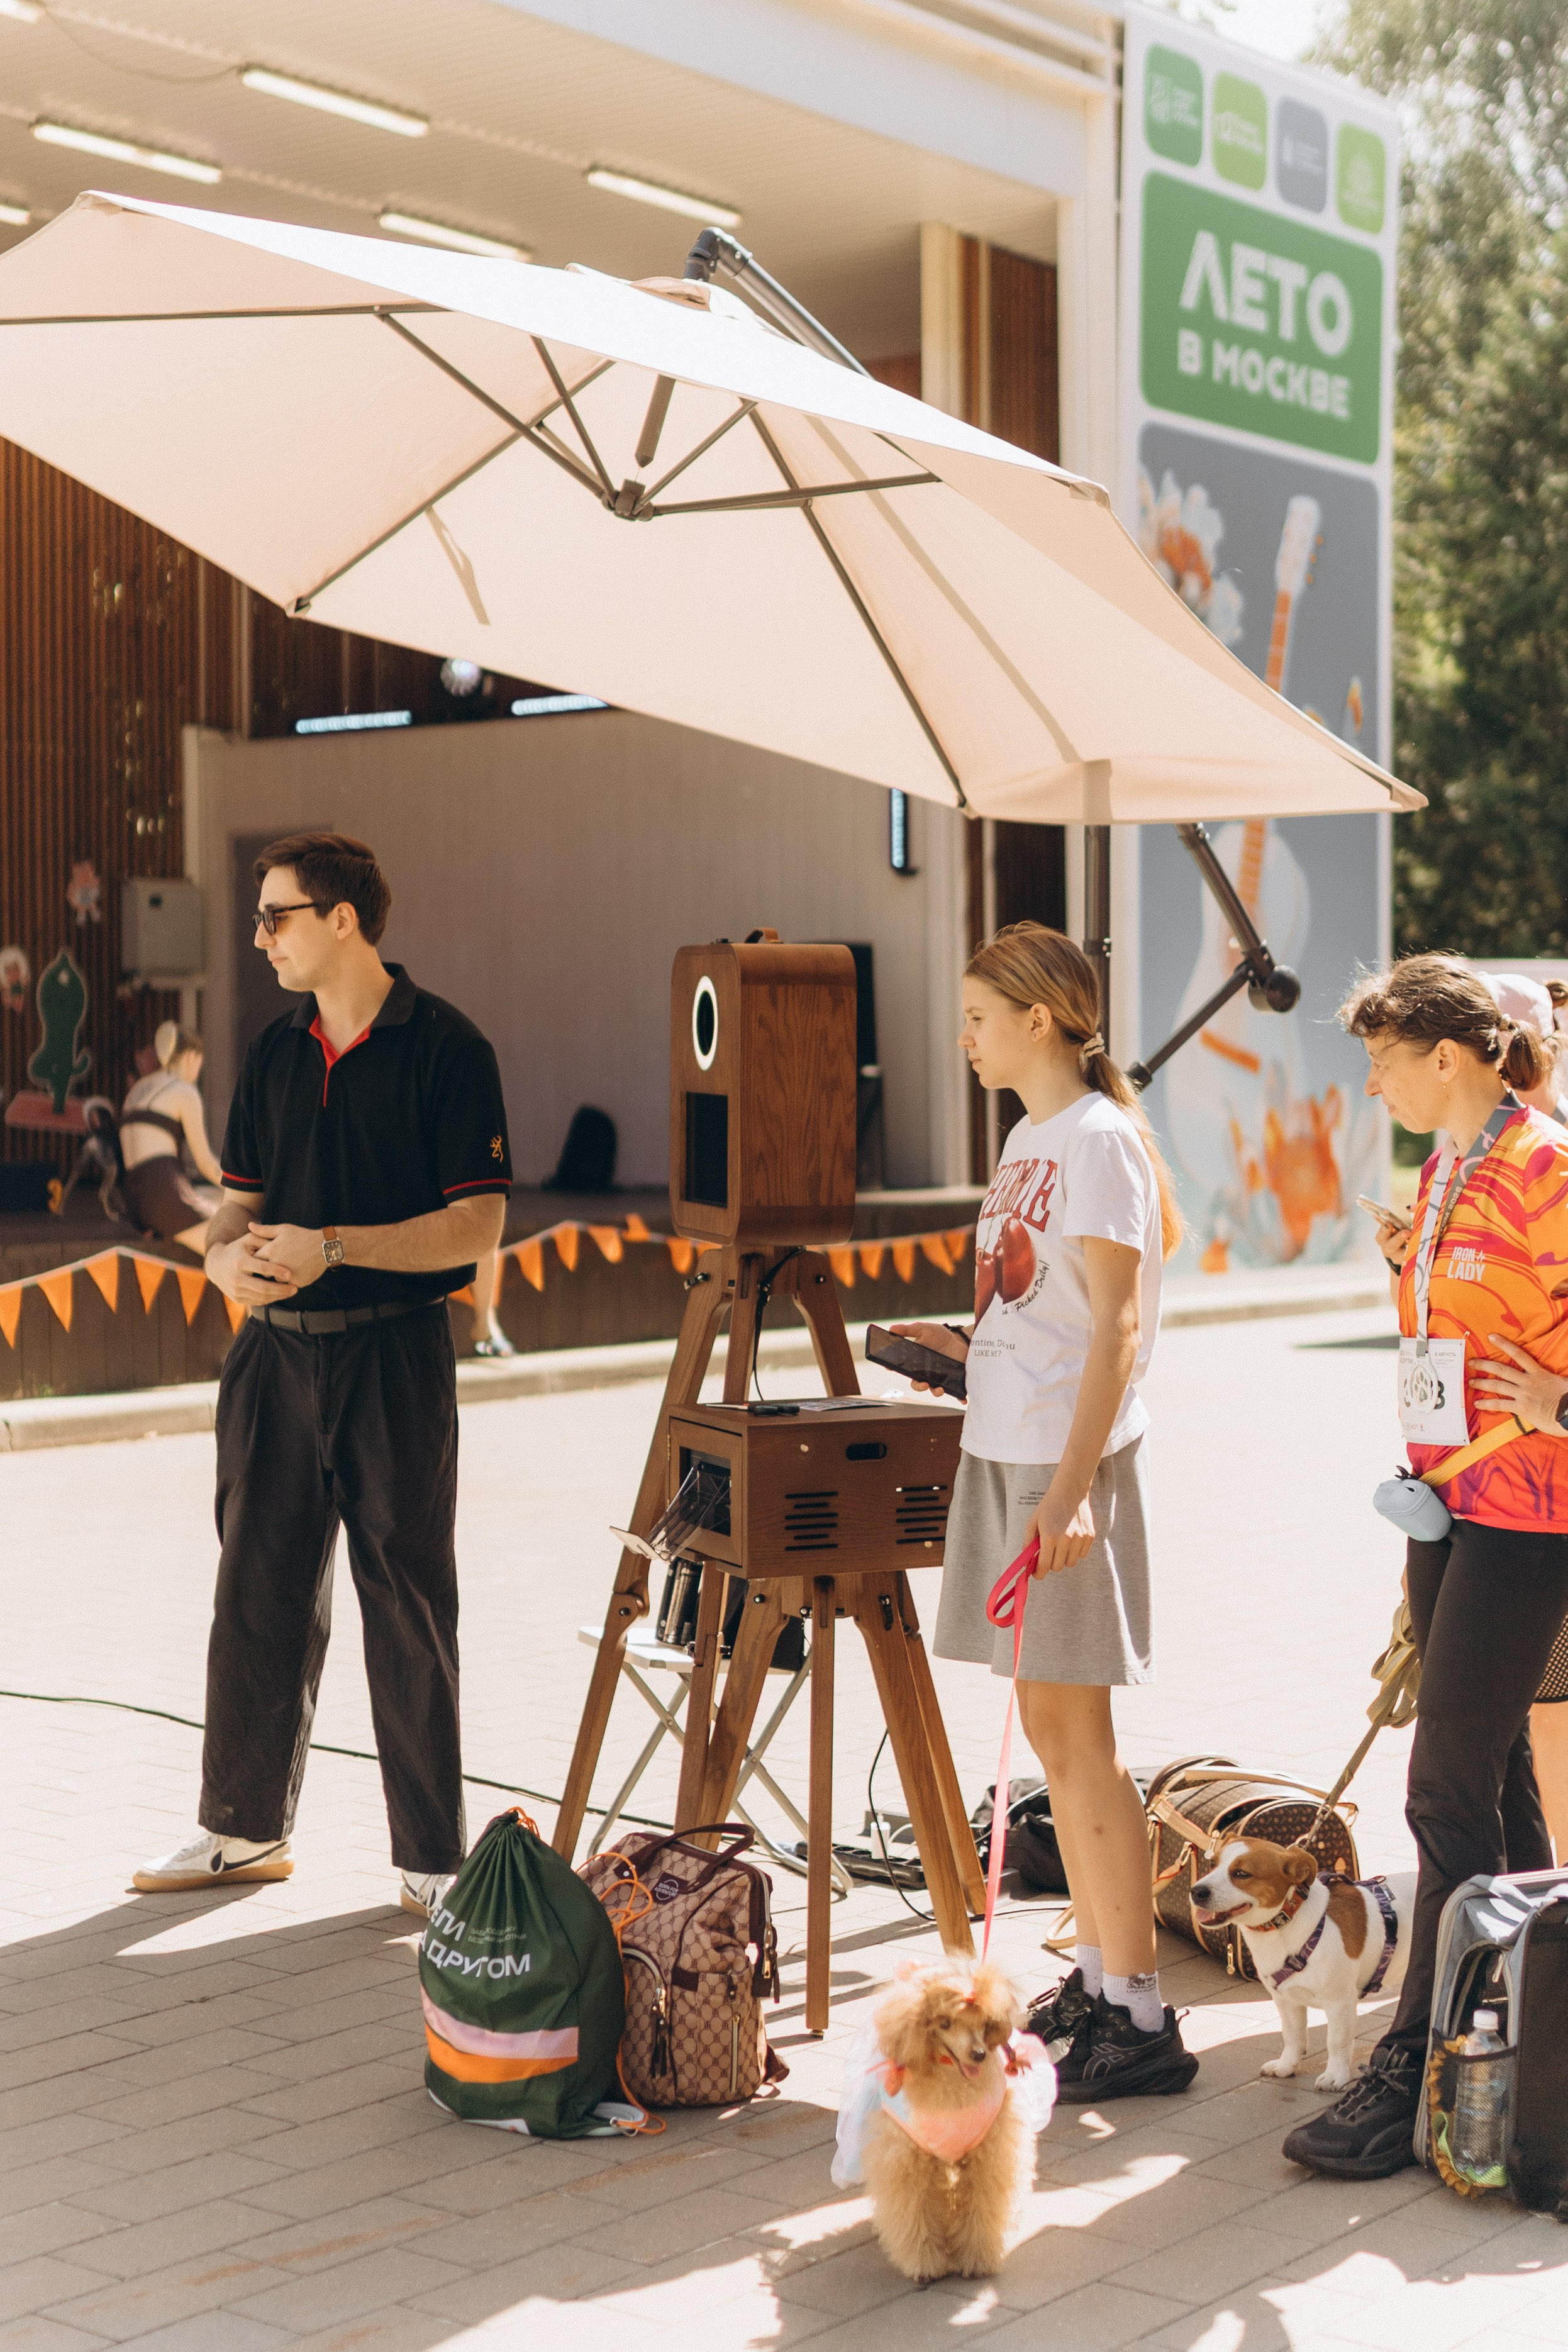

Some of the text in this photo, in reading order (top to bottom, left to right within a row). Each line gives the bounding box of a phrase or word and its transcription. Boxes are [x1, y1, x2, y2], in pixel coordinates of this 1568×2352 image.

[1180, 230, 1353, 357] ЛЕТО
[1178, 328, 1351, 421] В МОСКВЕ
[1452, 1246, 1476, 1262] IRON
[1447, 1261, 1486, 1282] LADY
[1015, 1288, 1039, 1312] Picked
[426, 1938, 530, 1980] ДРУГОМ
